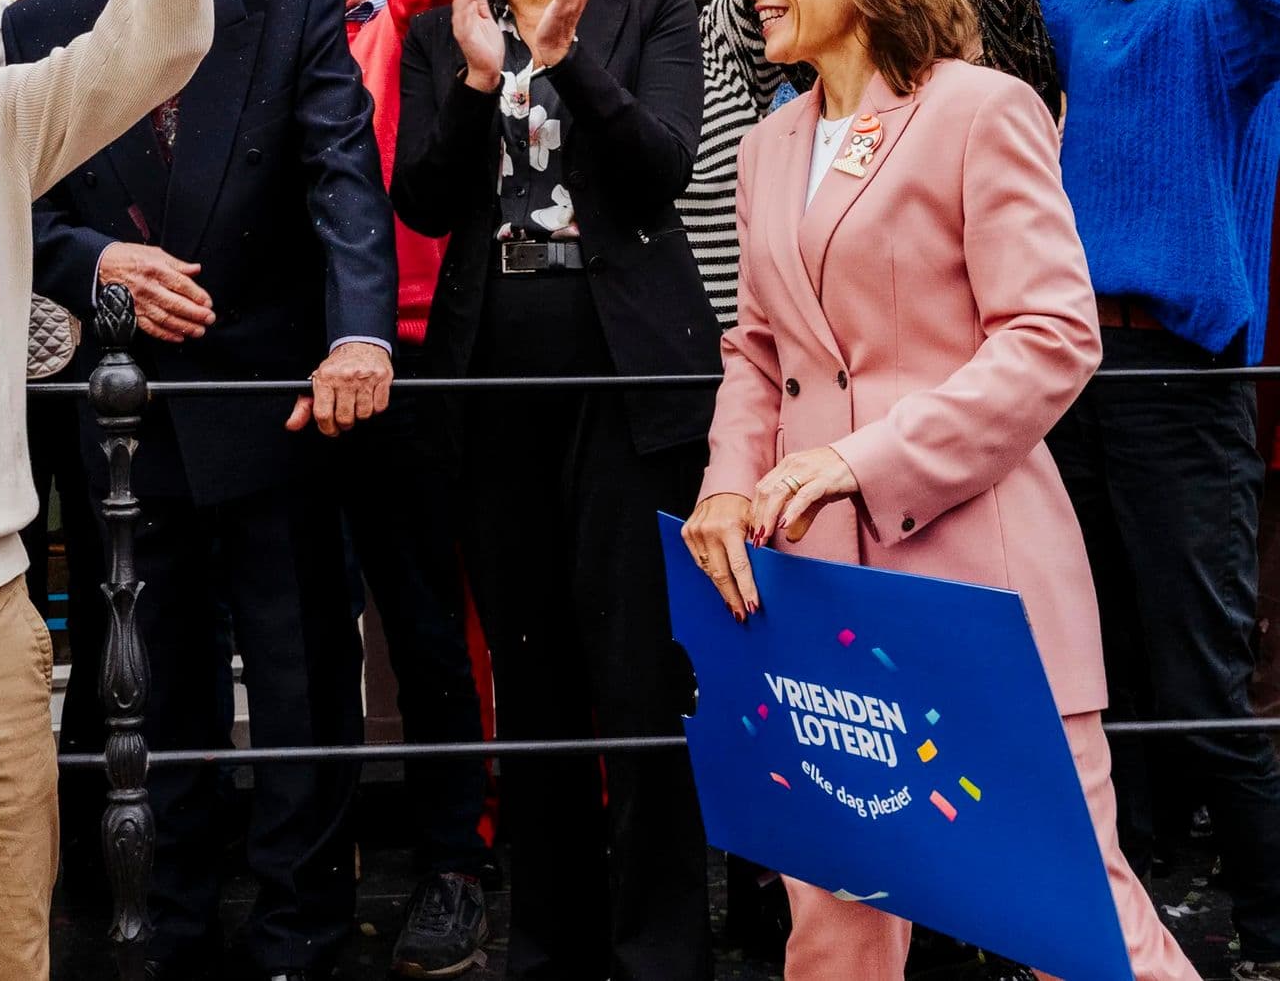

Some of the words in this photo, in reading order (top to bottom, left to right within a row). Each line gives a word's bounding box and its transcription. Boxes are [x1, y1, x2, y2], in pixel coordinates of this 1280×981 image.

[764, 672, 907, 734] VRIENDEN
[790, 711, 898, 768] LOTERIJ
[801, 760, 833, 795] elke
[836, 785, 868, 818] dag
[867, 785, 913, 820] plezier
